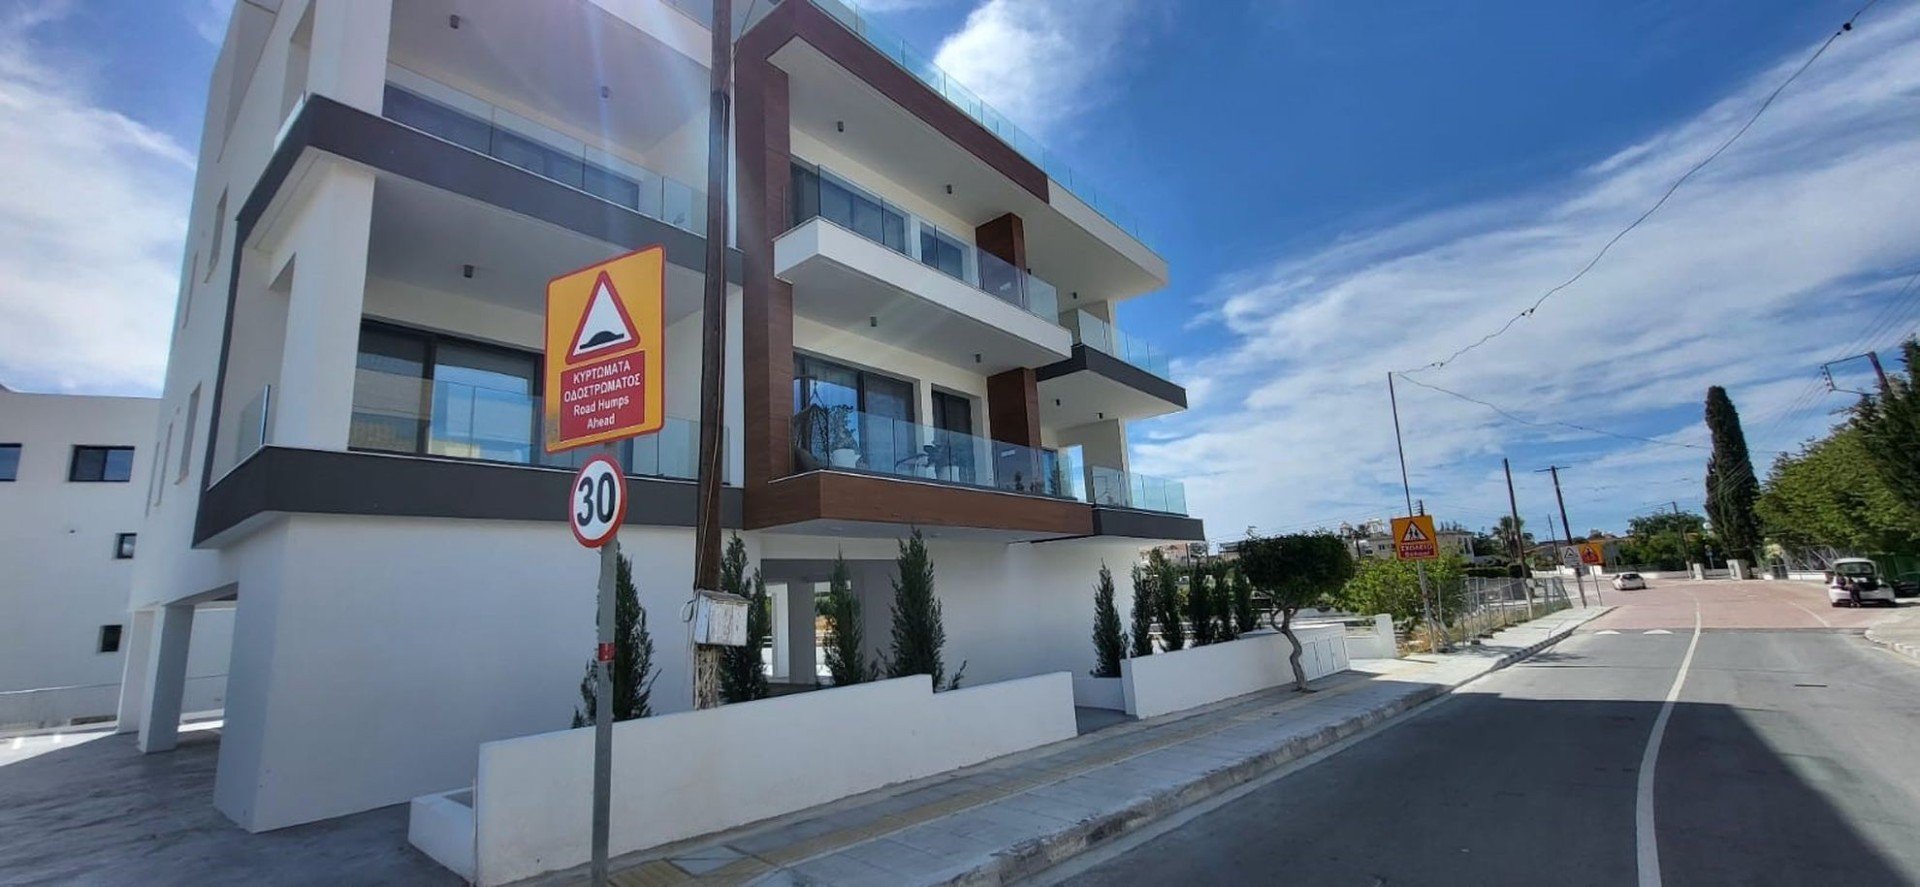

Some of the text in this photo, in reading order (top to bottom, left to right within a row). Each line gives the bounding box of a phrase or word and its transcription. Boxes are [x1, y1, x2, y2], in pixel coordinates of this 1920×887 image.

[573, 360, 631, 384] ΚΥΡΤΩΜΑΤΑ
[564, 373, 641, 402] ΟΔΟΣΤΡΩΜΑΤΟΣ
[574, 395, 630, 416] Road Humps
[587, 413, 615, 430] Ahead
[577, 472, 616, 526] 30
